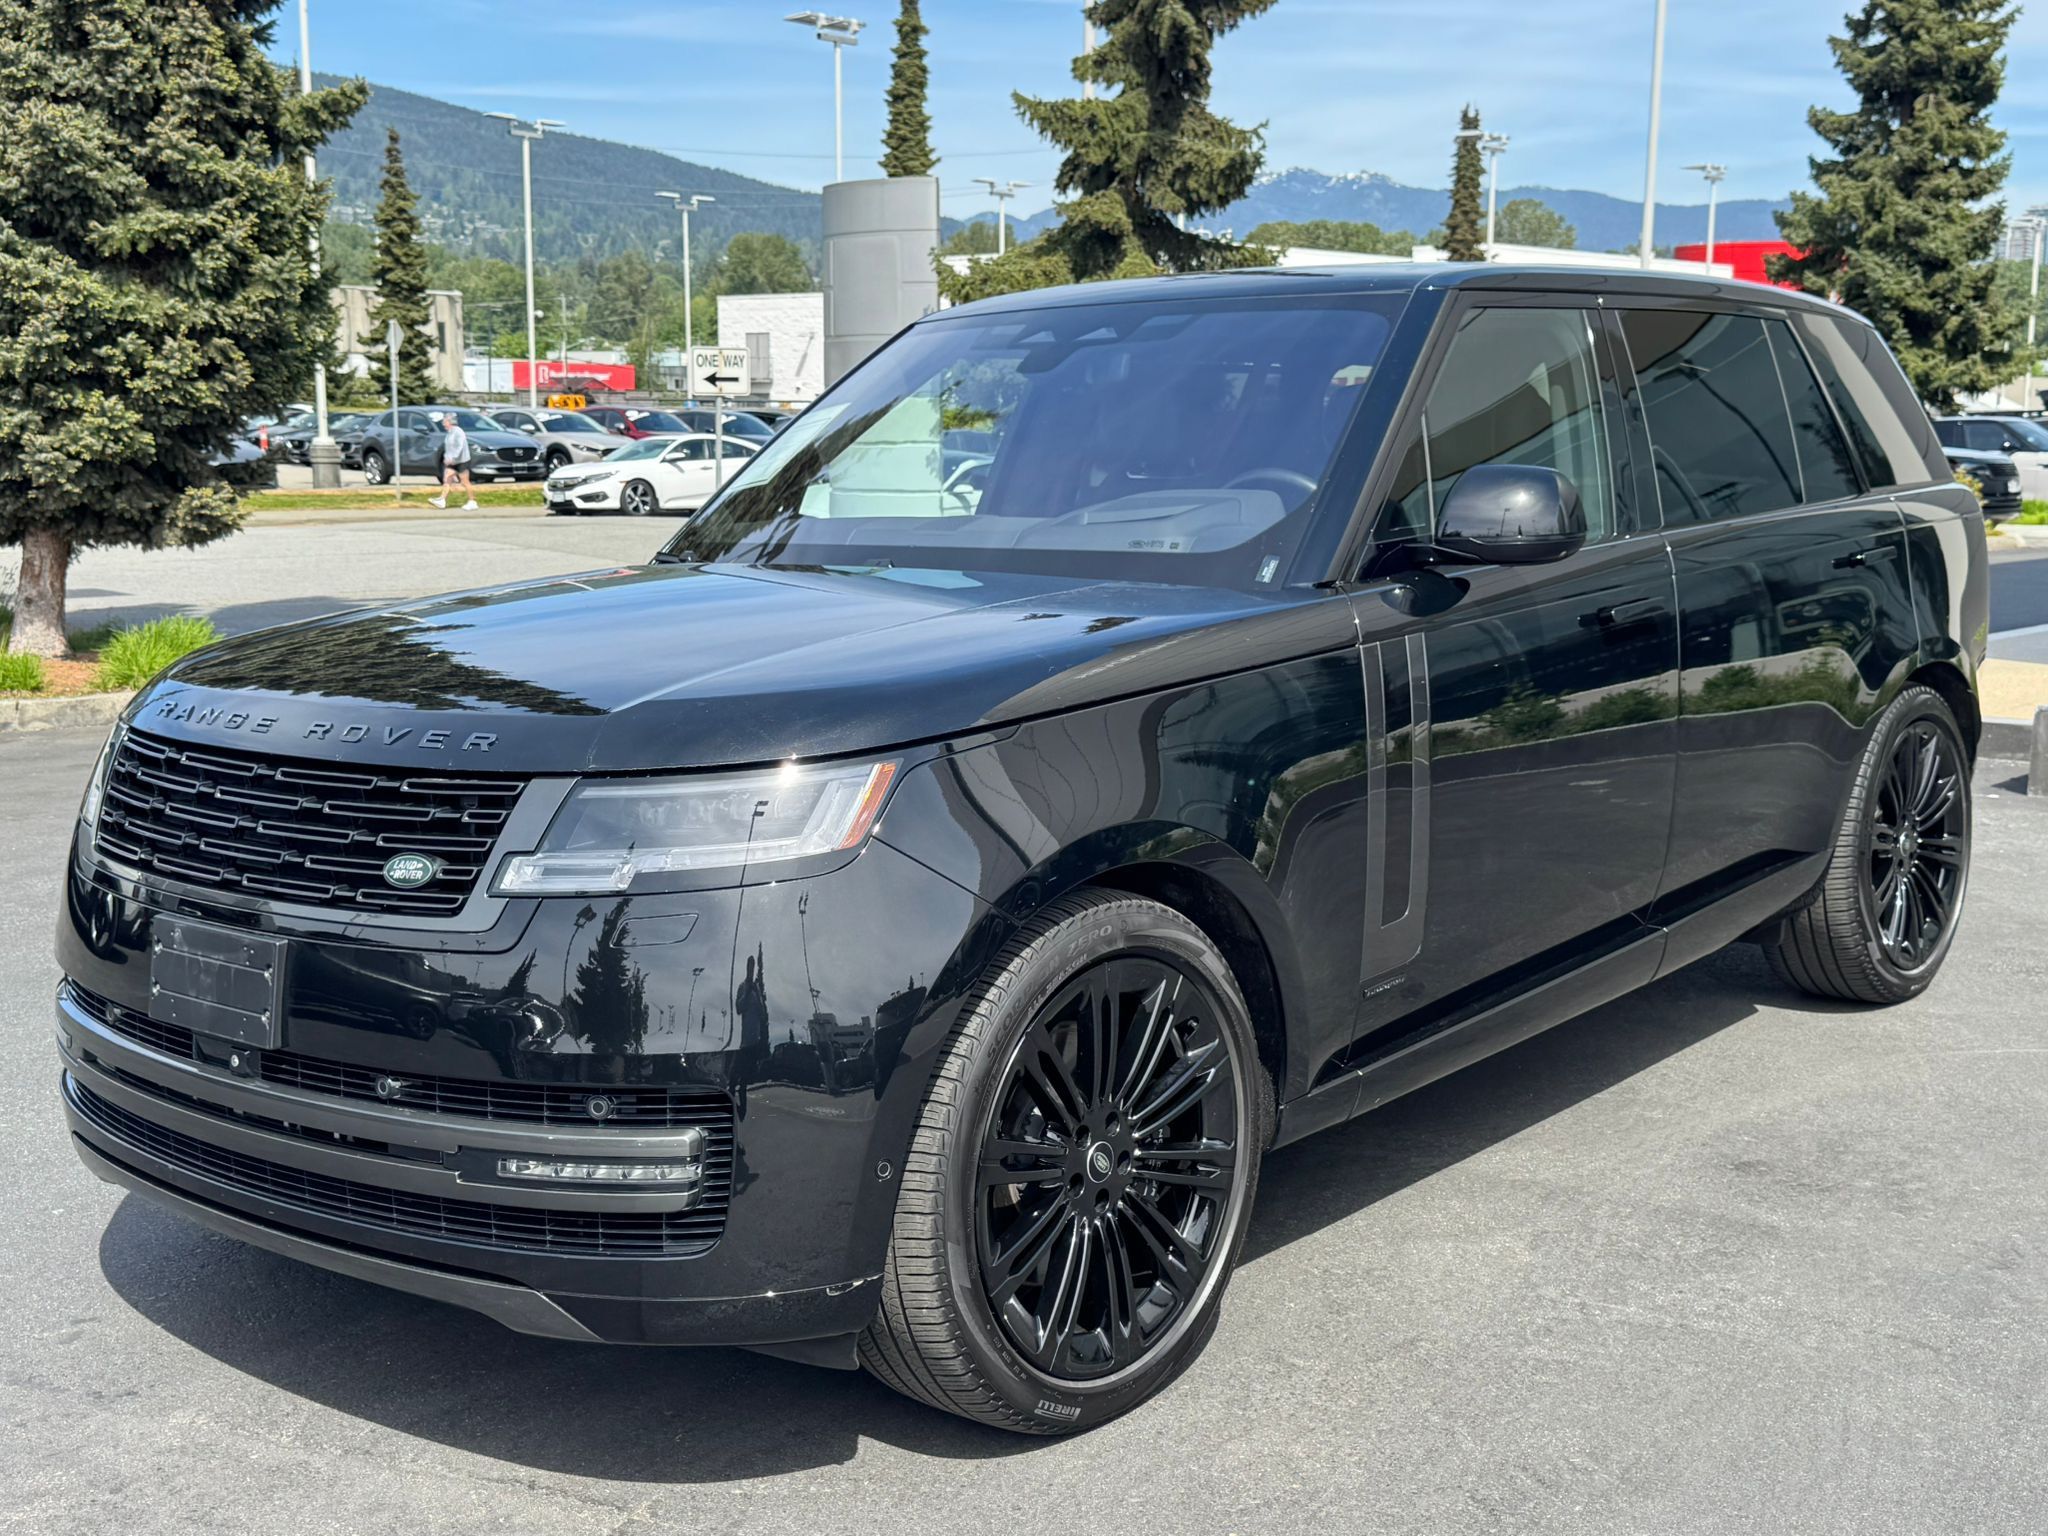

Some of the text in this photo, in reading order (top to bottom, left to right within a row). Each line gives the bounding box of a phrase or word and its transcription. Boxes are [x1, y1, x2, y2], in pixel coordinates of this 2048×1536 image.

[696, 354, 745, 368] ONE WAY
[155, 700, 499, 752] RANGE ROVER
[393, 860, 418, 870] LAND
[393, 869, 423, 880] ROVER
[1067, 925, 1112, 957] ZERO
[1034, 1400, 1081, 1421] PIRELLI
